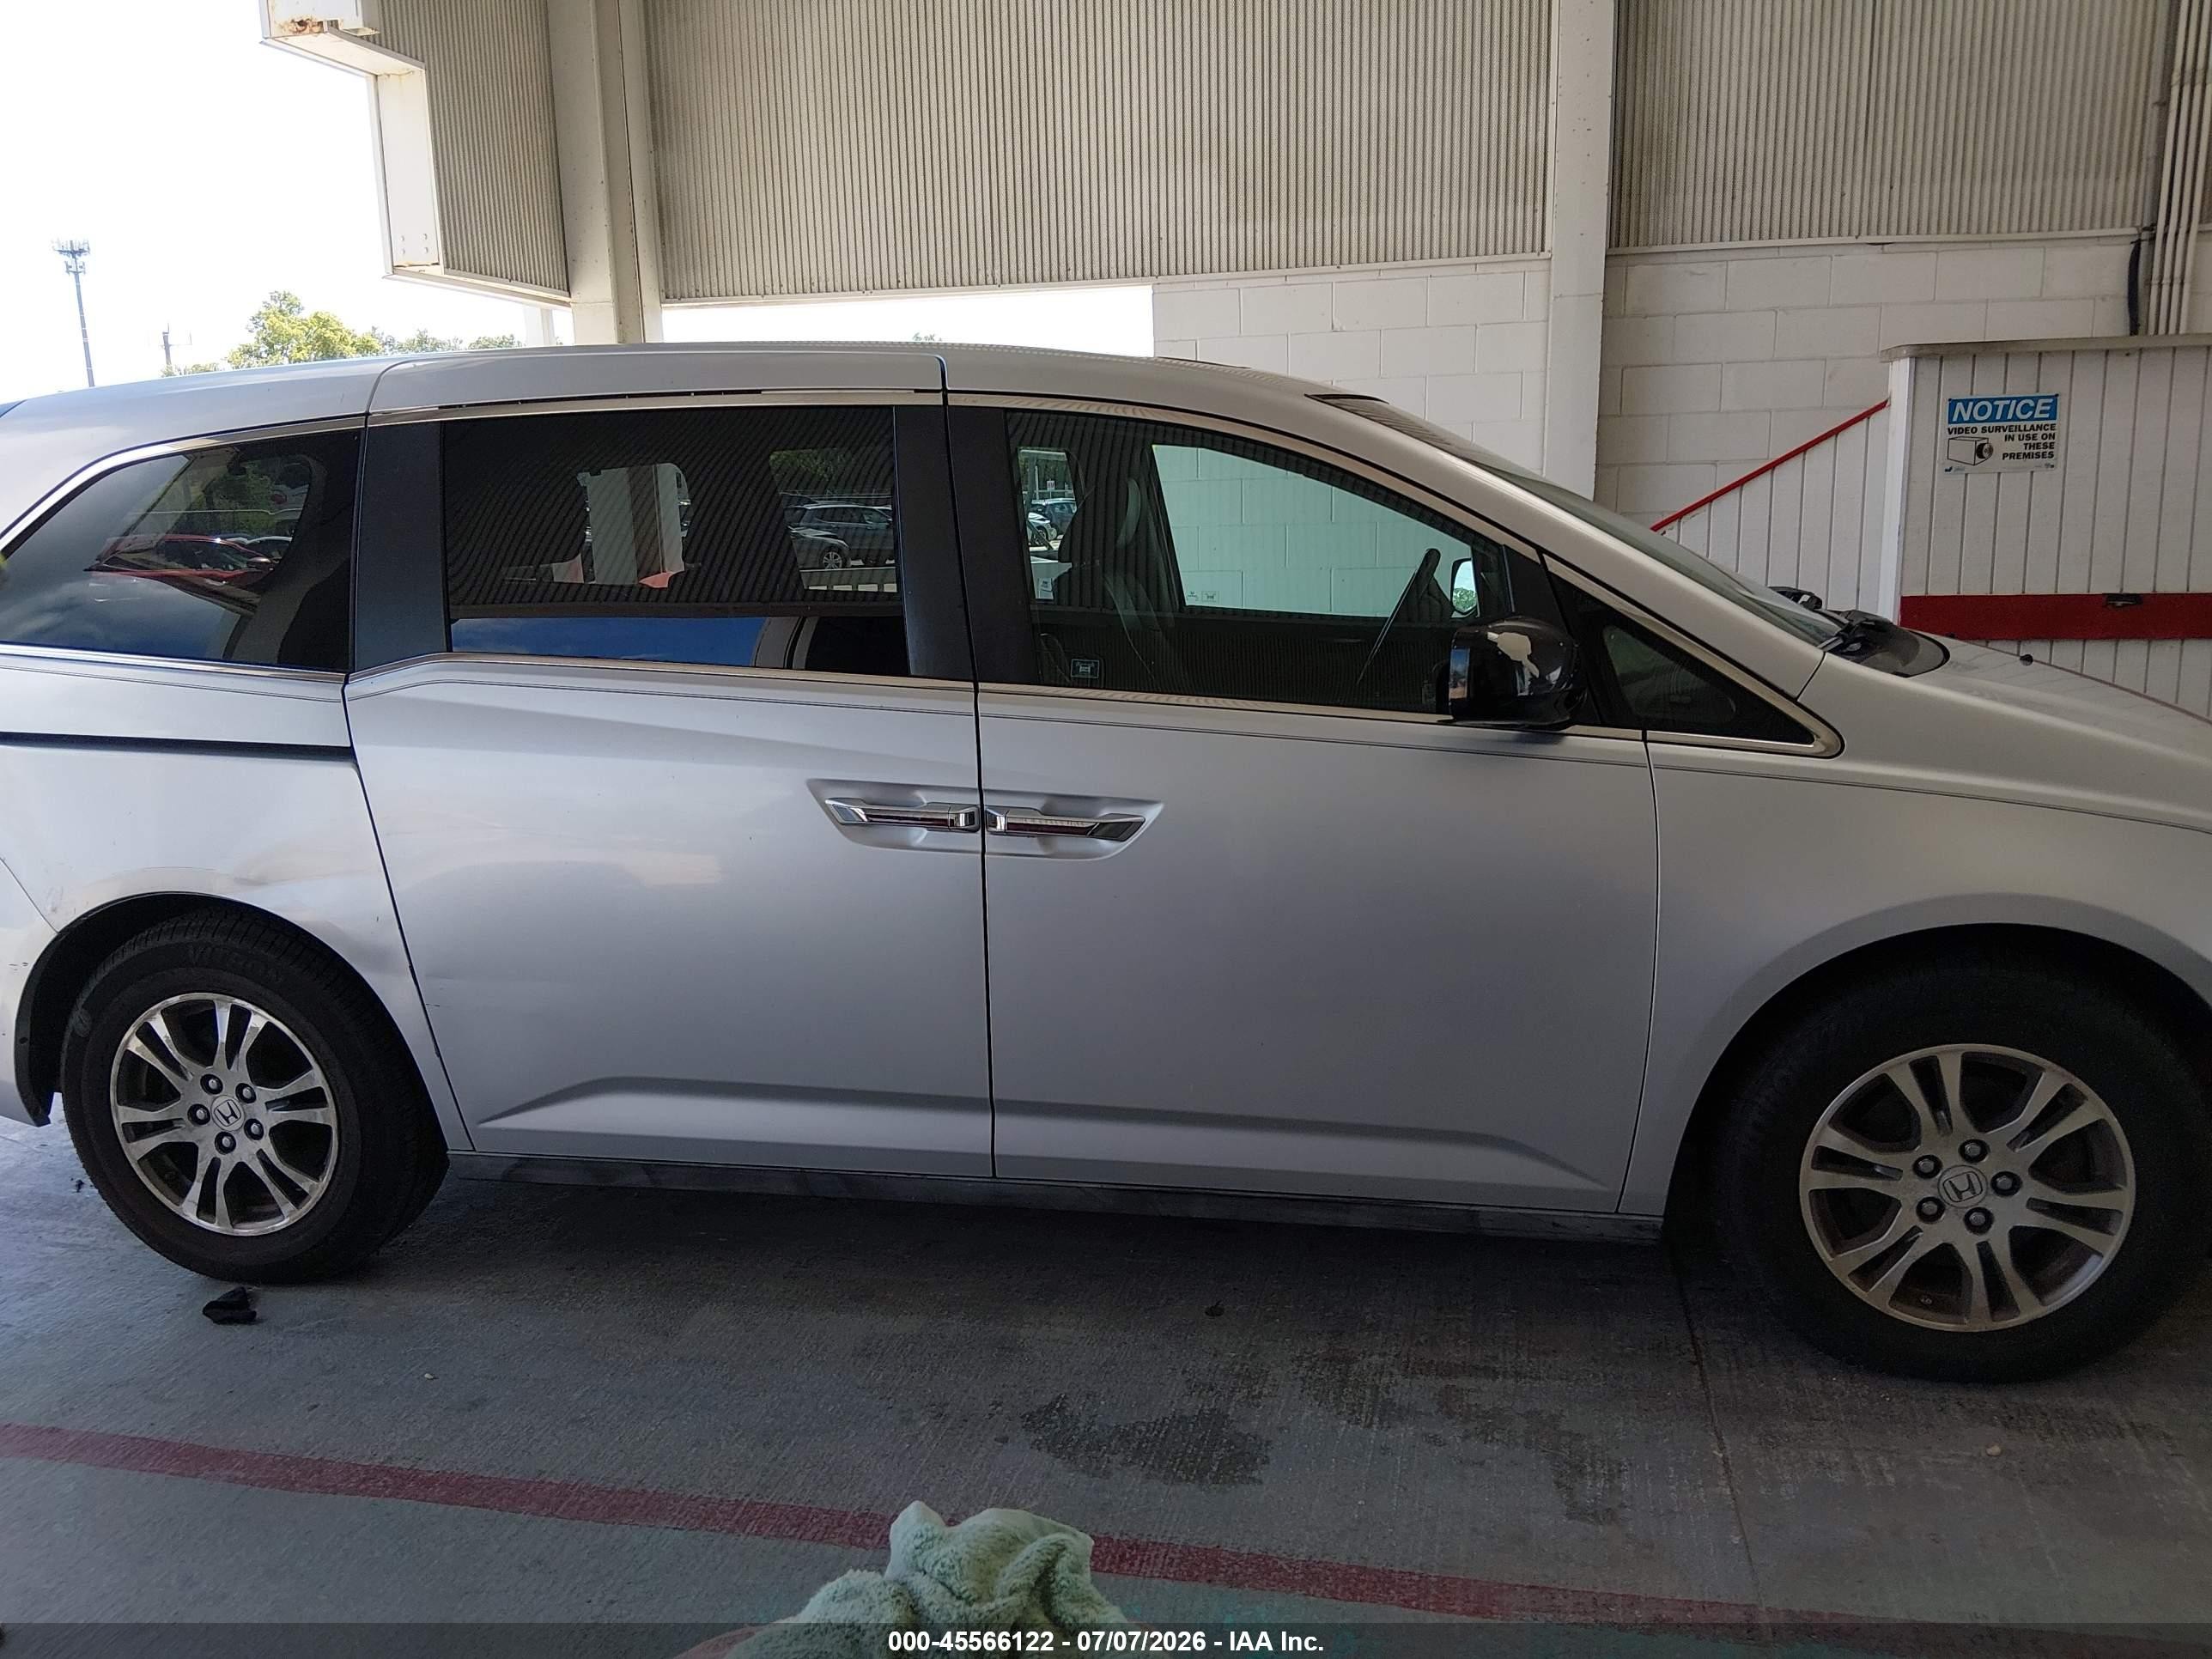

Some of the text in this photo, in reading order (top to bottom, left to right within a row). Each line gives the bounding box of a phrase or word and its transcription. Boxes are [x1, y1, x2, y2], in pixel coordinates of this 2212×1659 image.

[1952, 398, 2054, 422] NOTICE
[1948, 423, 2057, 435] VIDEO SURVEILLANCE
[2002, 451, 2054, 460] PREMISES
